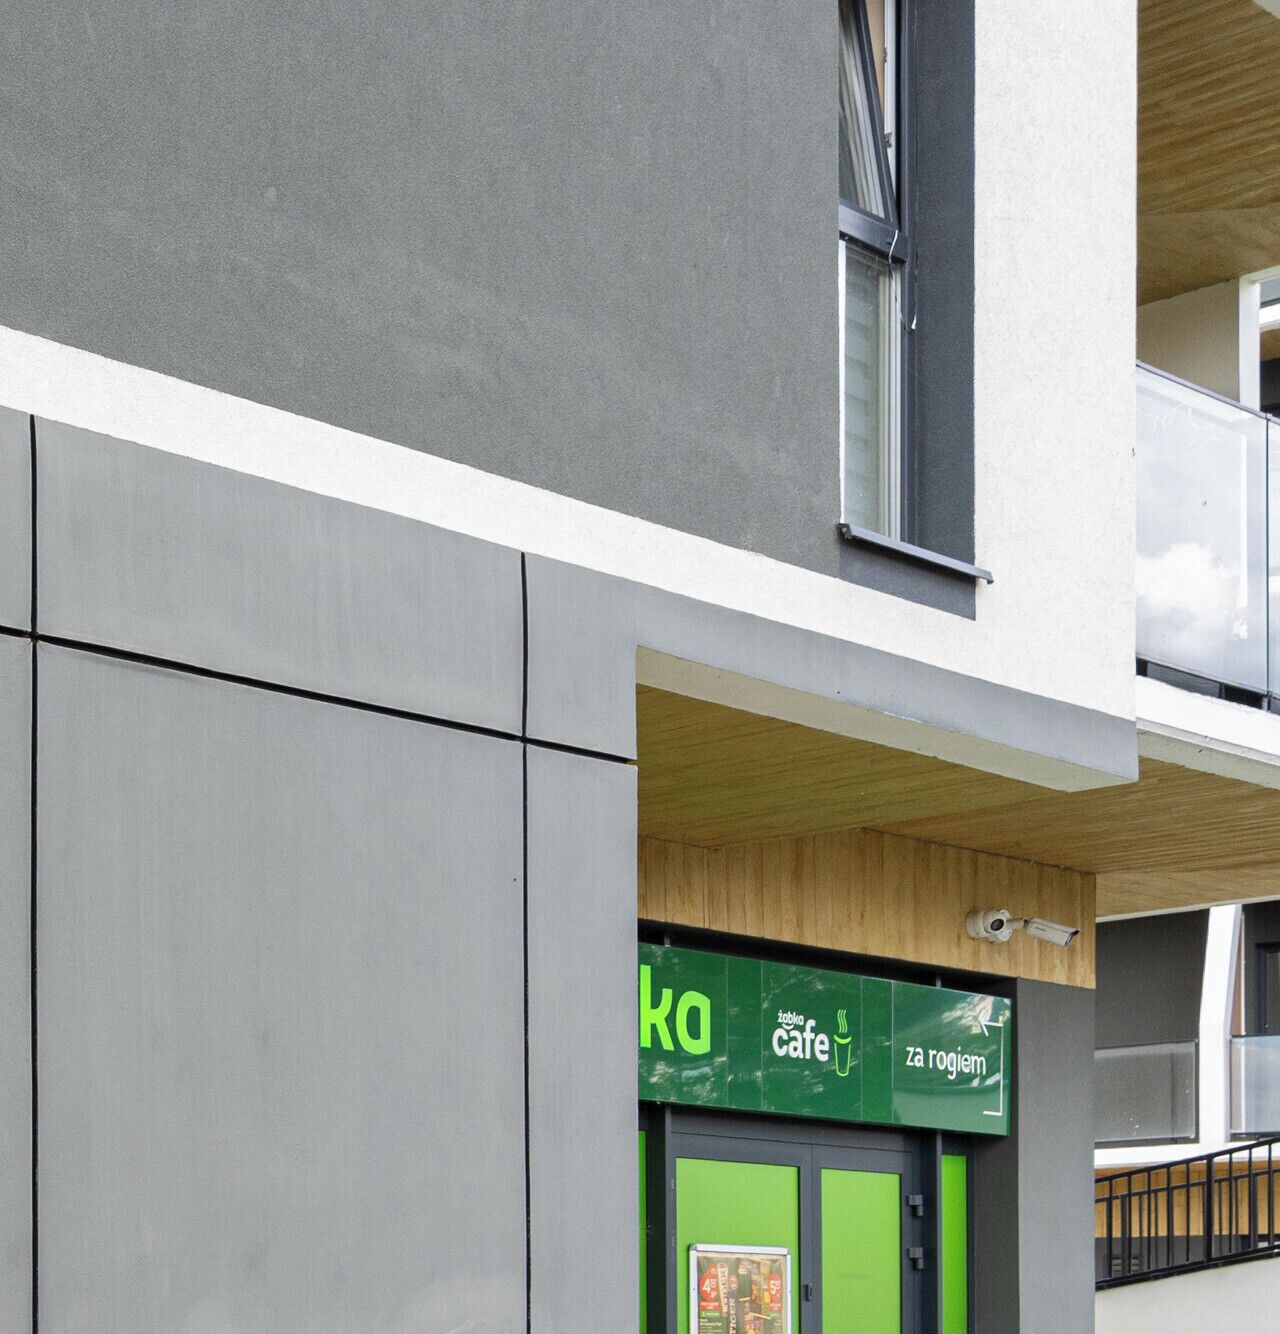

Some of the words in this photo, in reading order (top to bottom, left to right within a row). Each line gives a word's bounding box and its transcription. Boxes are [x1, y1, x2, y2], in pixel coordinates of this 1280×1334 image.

[772, 1019, 830, 1062] cafe
[906, 1045, 925, 1068] za
[929, 1046, 987, 1081] rogiem
